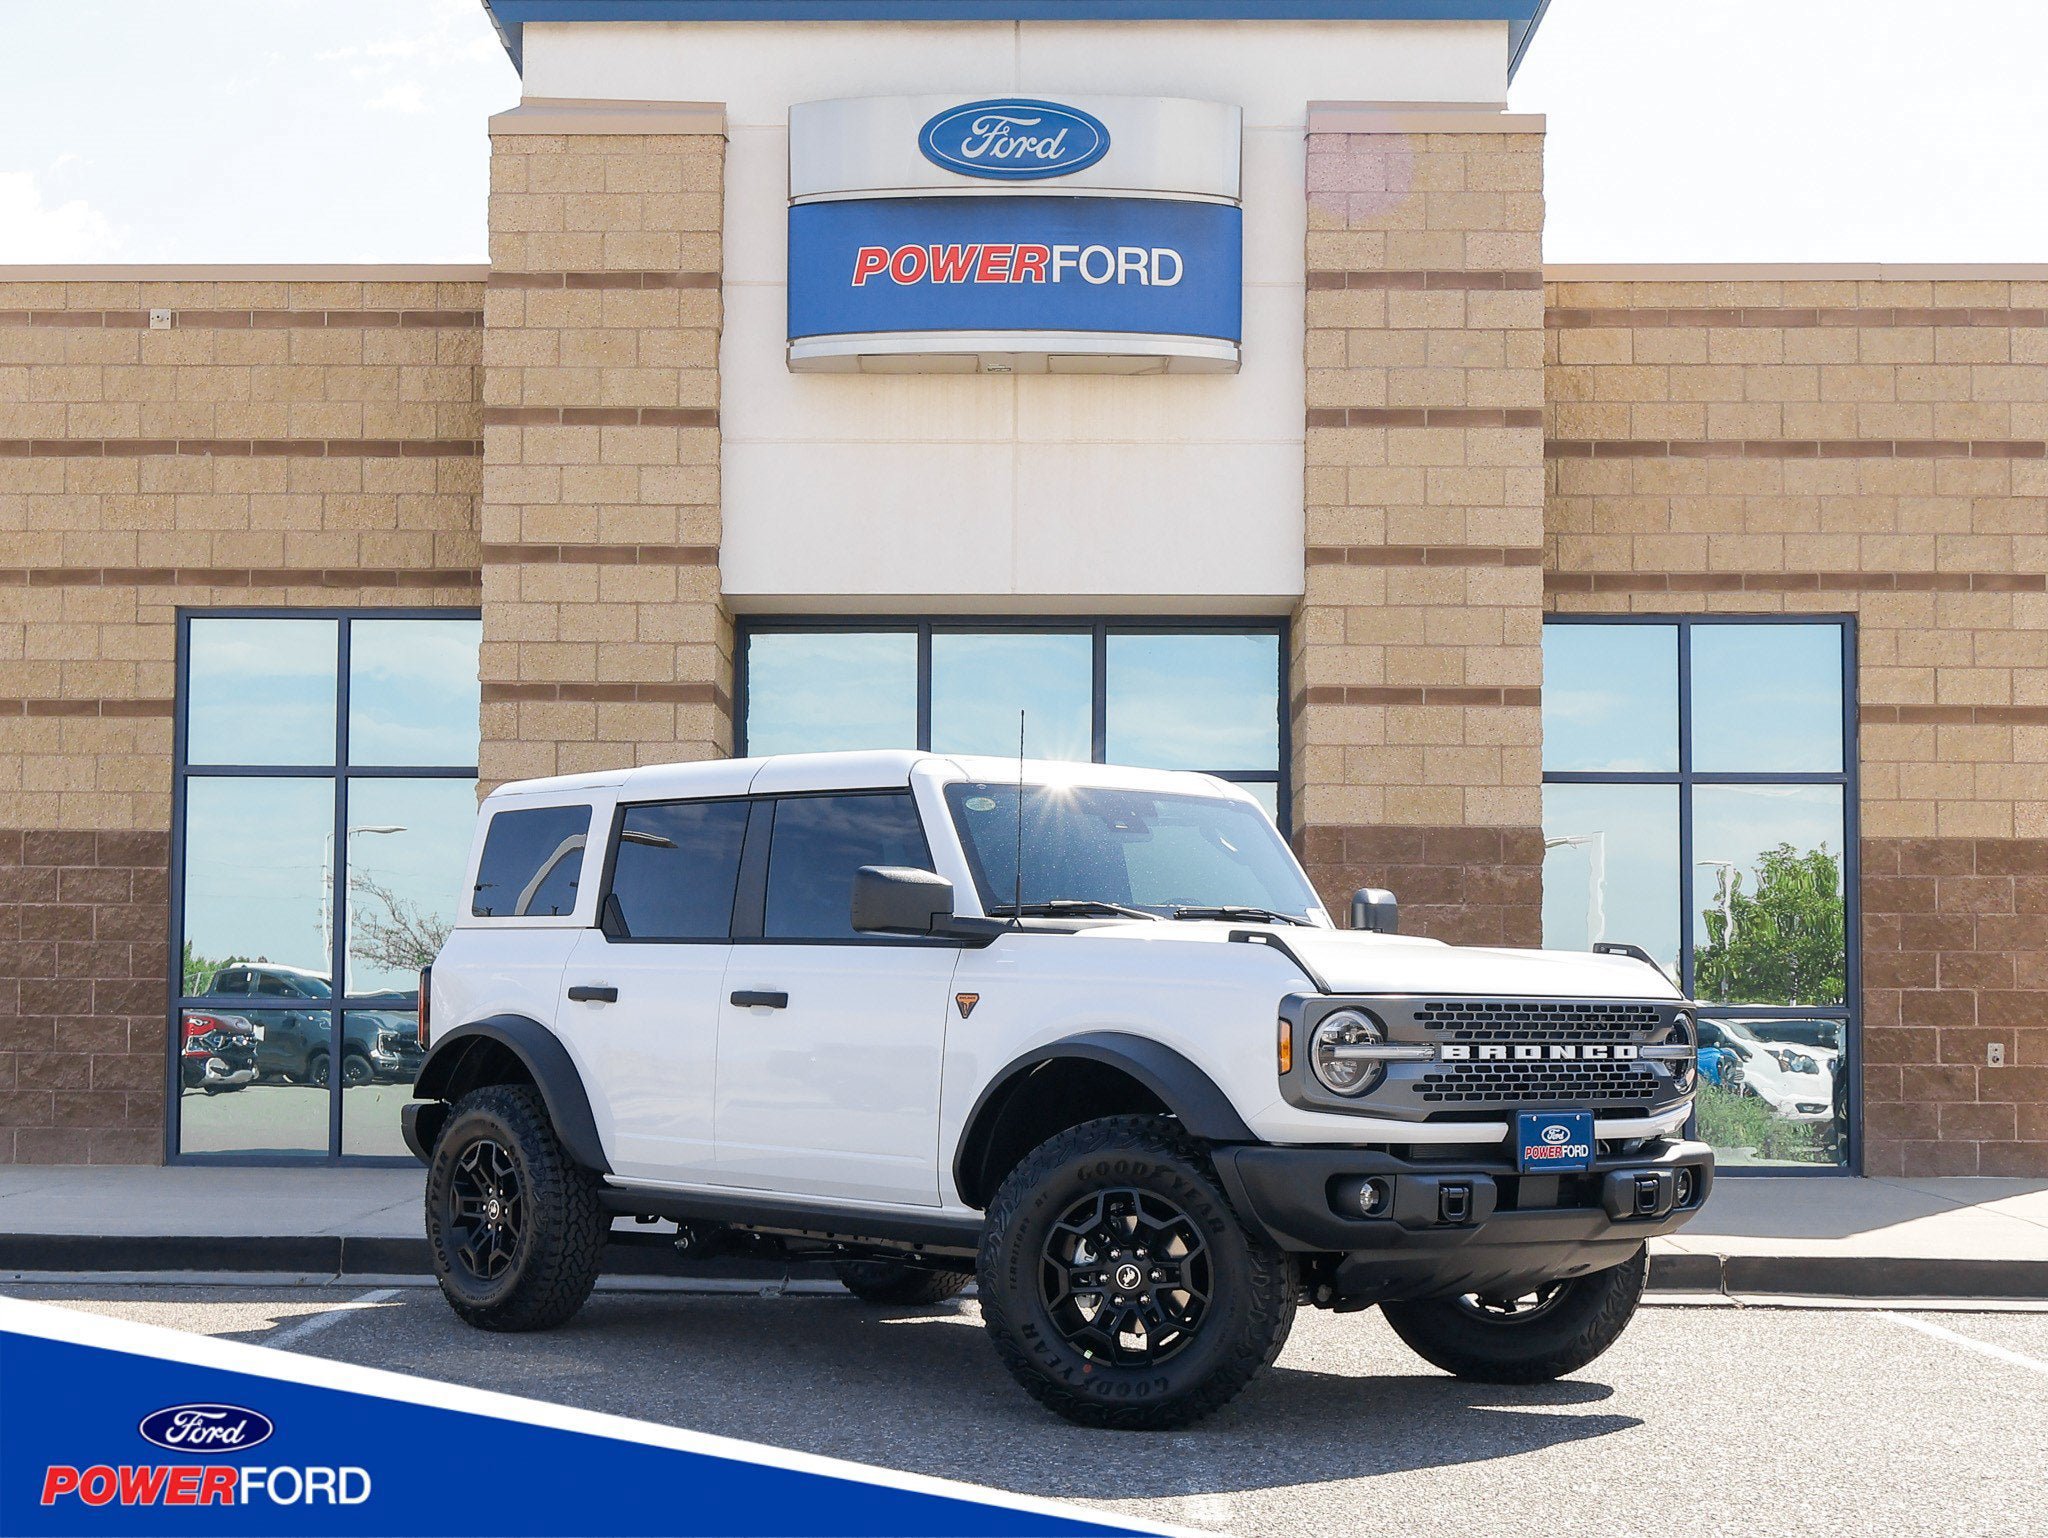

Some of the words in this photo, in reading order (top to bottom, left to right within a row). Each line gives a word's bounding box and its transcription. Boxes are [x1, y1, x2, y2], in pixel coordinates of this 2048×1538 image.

[961, 115, 1068, 160] Ford
[851, 244, 1183, 287] POWERFORD
[1441, 1045, 1638, 1060] BRONCO
[1525, 1145, 1588, 1159] POWERFORD
[1547, 1129, 1565, 1140] Ford
[1077, 1159, 1226, 1234] GOODYEAR
[1021, 1322, 1169, 1397] GOODYEAR
